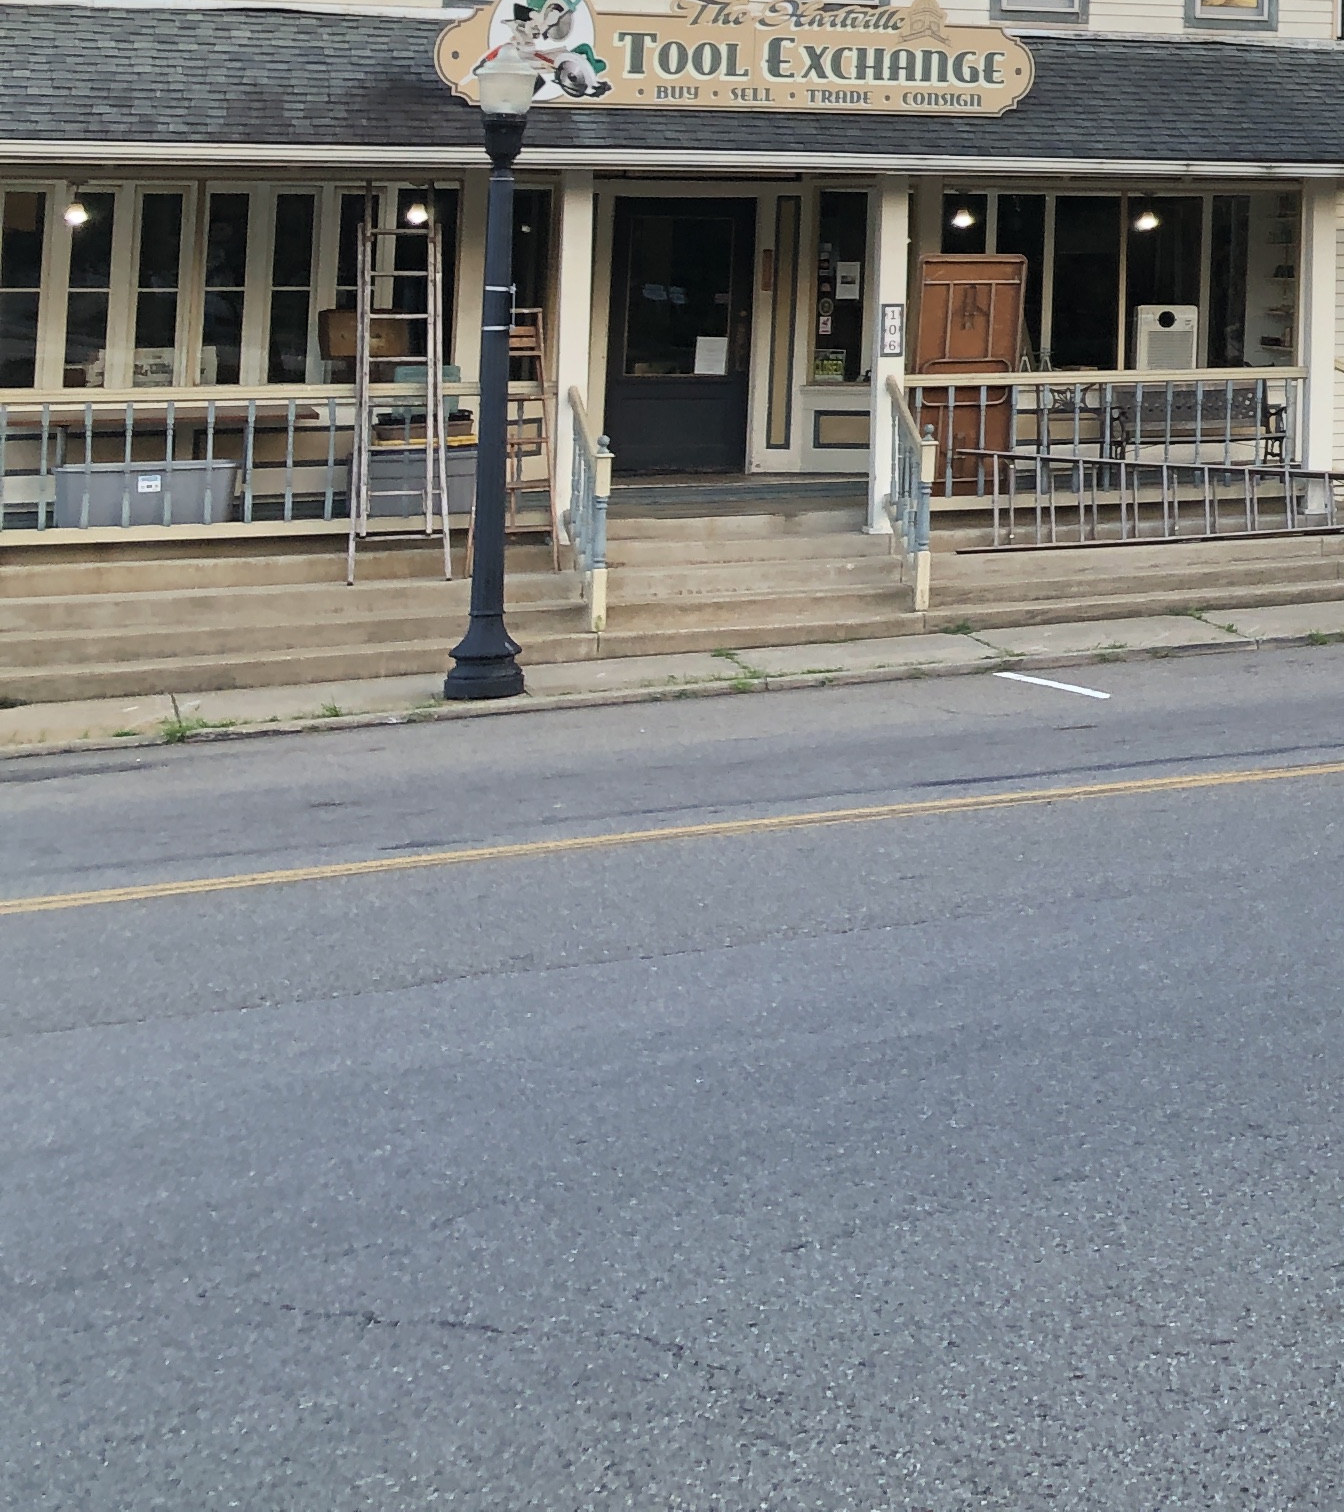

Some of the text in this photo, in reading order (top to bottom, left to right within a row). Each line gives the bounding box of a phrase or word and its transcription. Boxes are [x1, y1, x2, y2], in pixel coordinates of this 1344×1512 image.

[617, 32, 1005, 87] TOOL EXCHANGE
[656, 86, 983, 108] BUY SELL TRADE CONSIGN
[888, 310, 897, 351] 106
